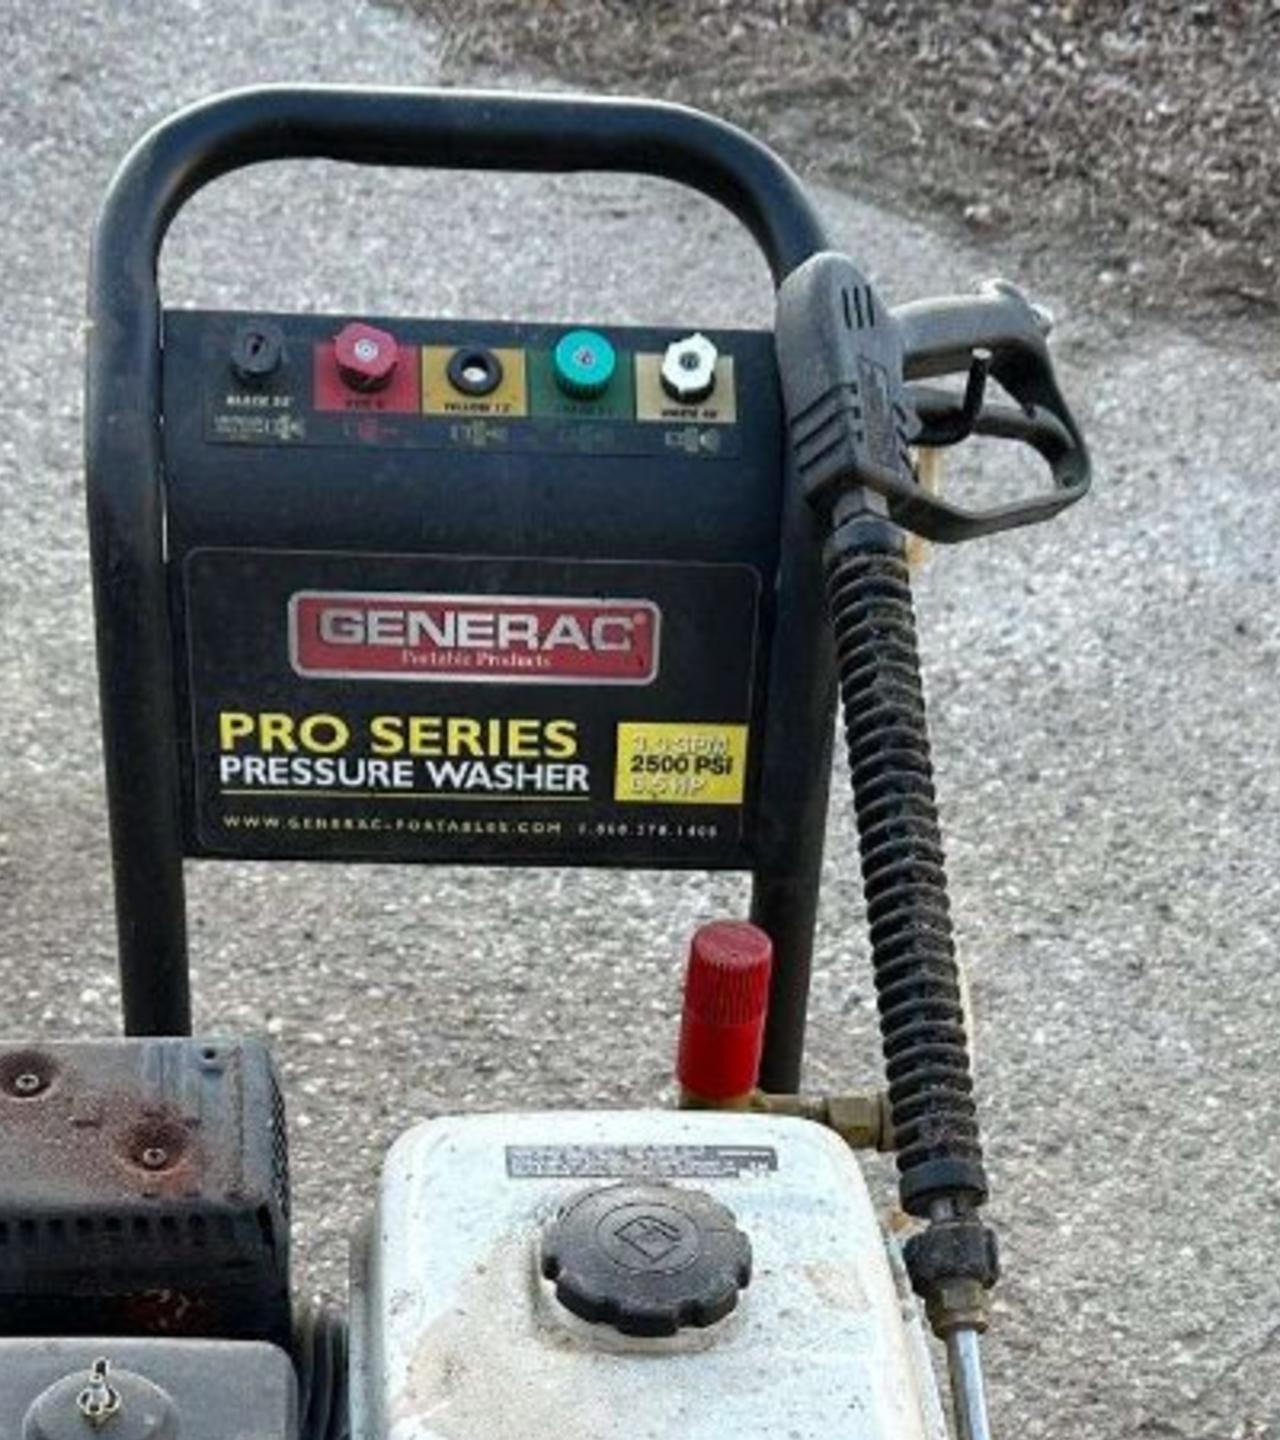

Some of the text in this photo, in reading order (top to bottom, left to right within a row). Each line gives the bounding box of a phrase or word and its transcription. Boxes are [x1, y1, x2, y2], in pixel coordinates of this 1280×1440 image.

[320, 608, 634, 651] GENERAC
[402, 649, 551, 668] Portable Products
[220, 712, 578, 759] PRO SERIES
[220, 755, 590, 792] PRESSURE WASHER
[629, 753, 735, 776] 2500 PSI
